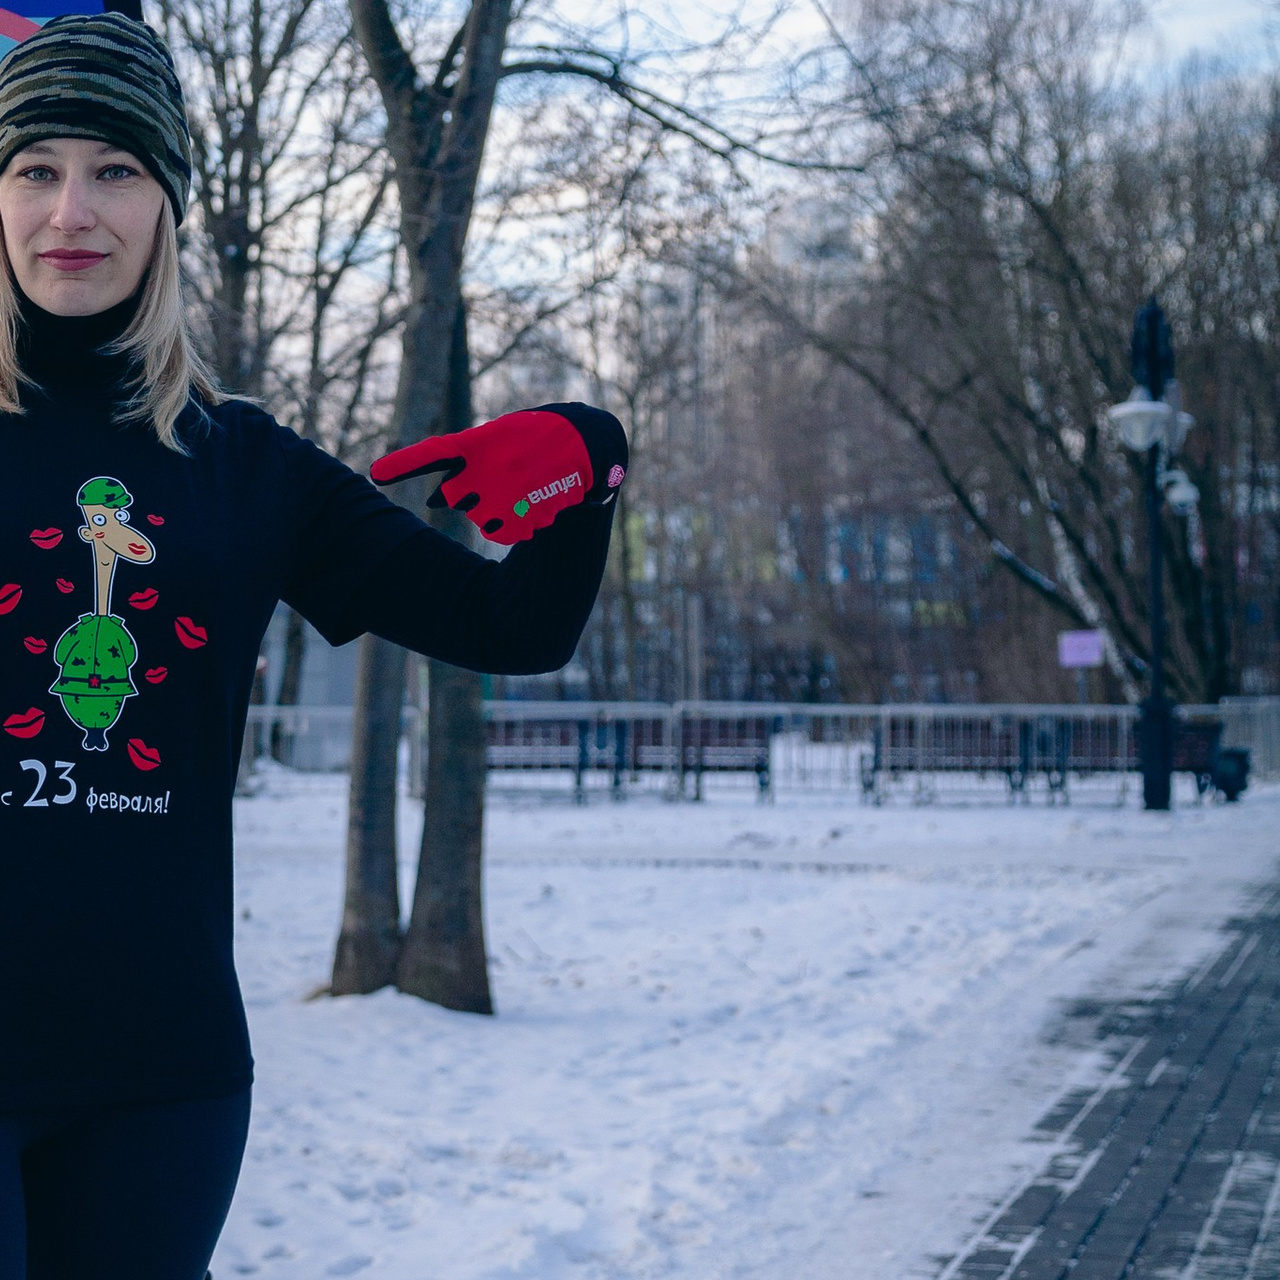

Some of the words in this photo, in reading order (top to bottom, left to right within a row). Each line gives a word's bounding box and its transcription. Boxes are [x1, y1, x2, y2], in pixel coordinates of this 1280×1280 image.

[527, 472, 582, 505] Lafuma
[19, 759, 77, 807] 23
[86, 787, 170, 814] февраля!
